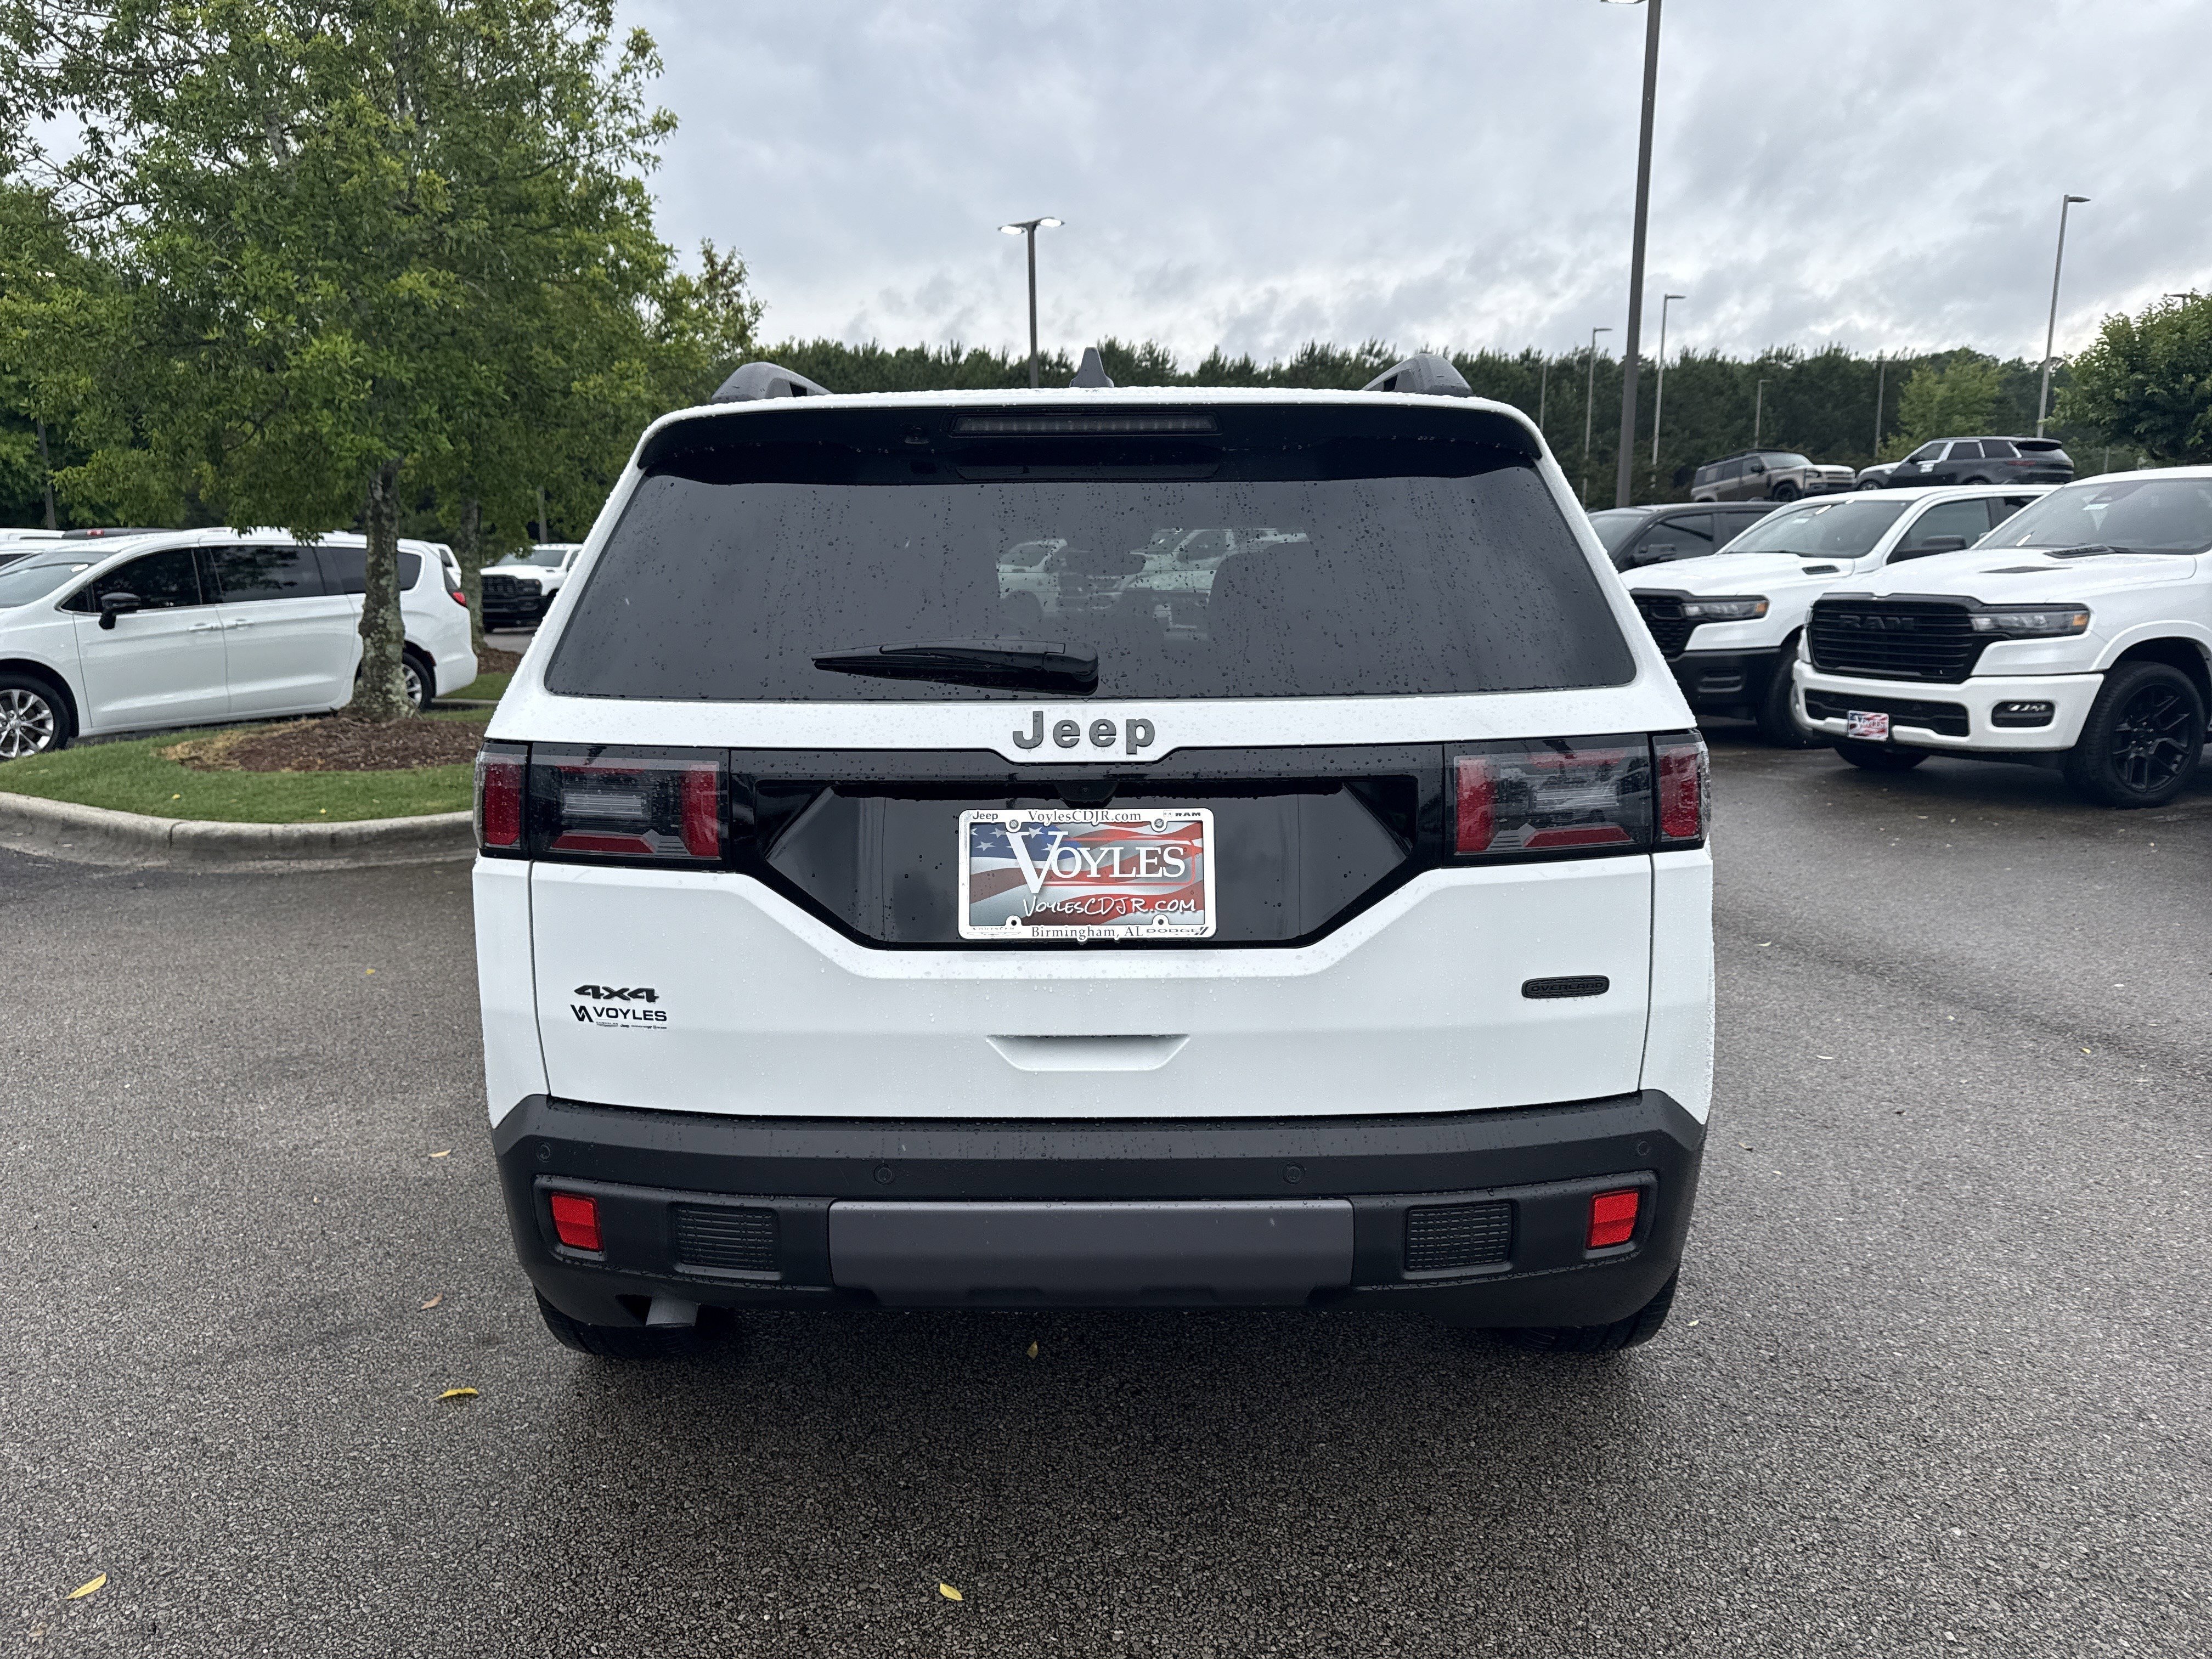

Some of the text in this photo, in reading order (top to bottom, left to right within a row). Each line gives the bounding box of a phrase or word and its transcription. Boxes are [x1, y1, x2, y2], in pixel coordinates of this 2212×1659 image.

[1013, 710, 1155, 754] Jeep
[972, 811, 998, 820] Jeep
[1028, 810, 1142, 825] VoylesCDJR.com
[1006, 831, 1186, 894] VOYLES
[1031, 926, 1143, 939] Birmingham, AL
[592, 1006, 667, 1022] VOYLES
